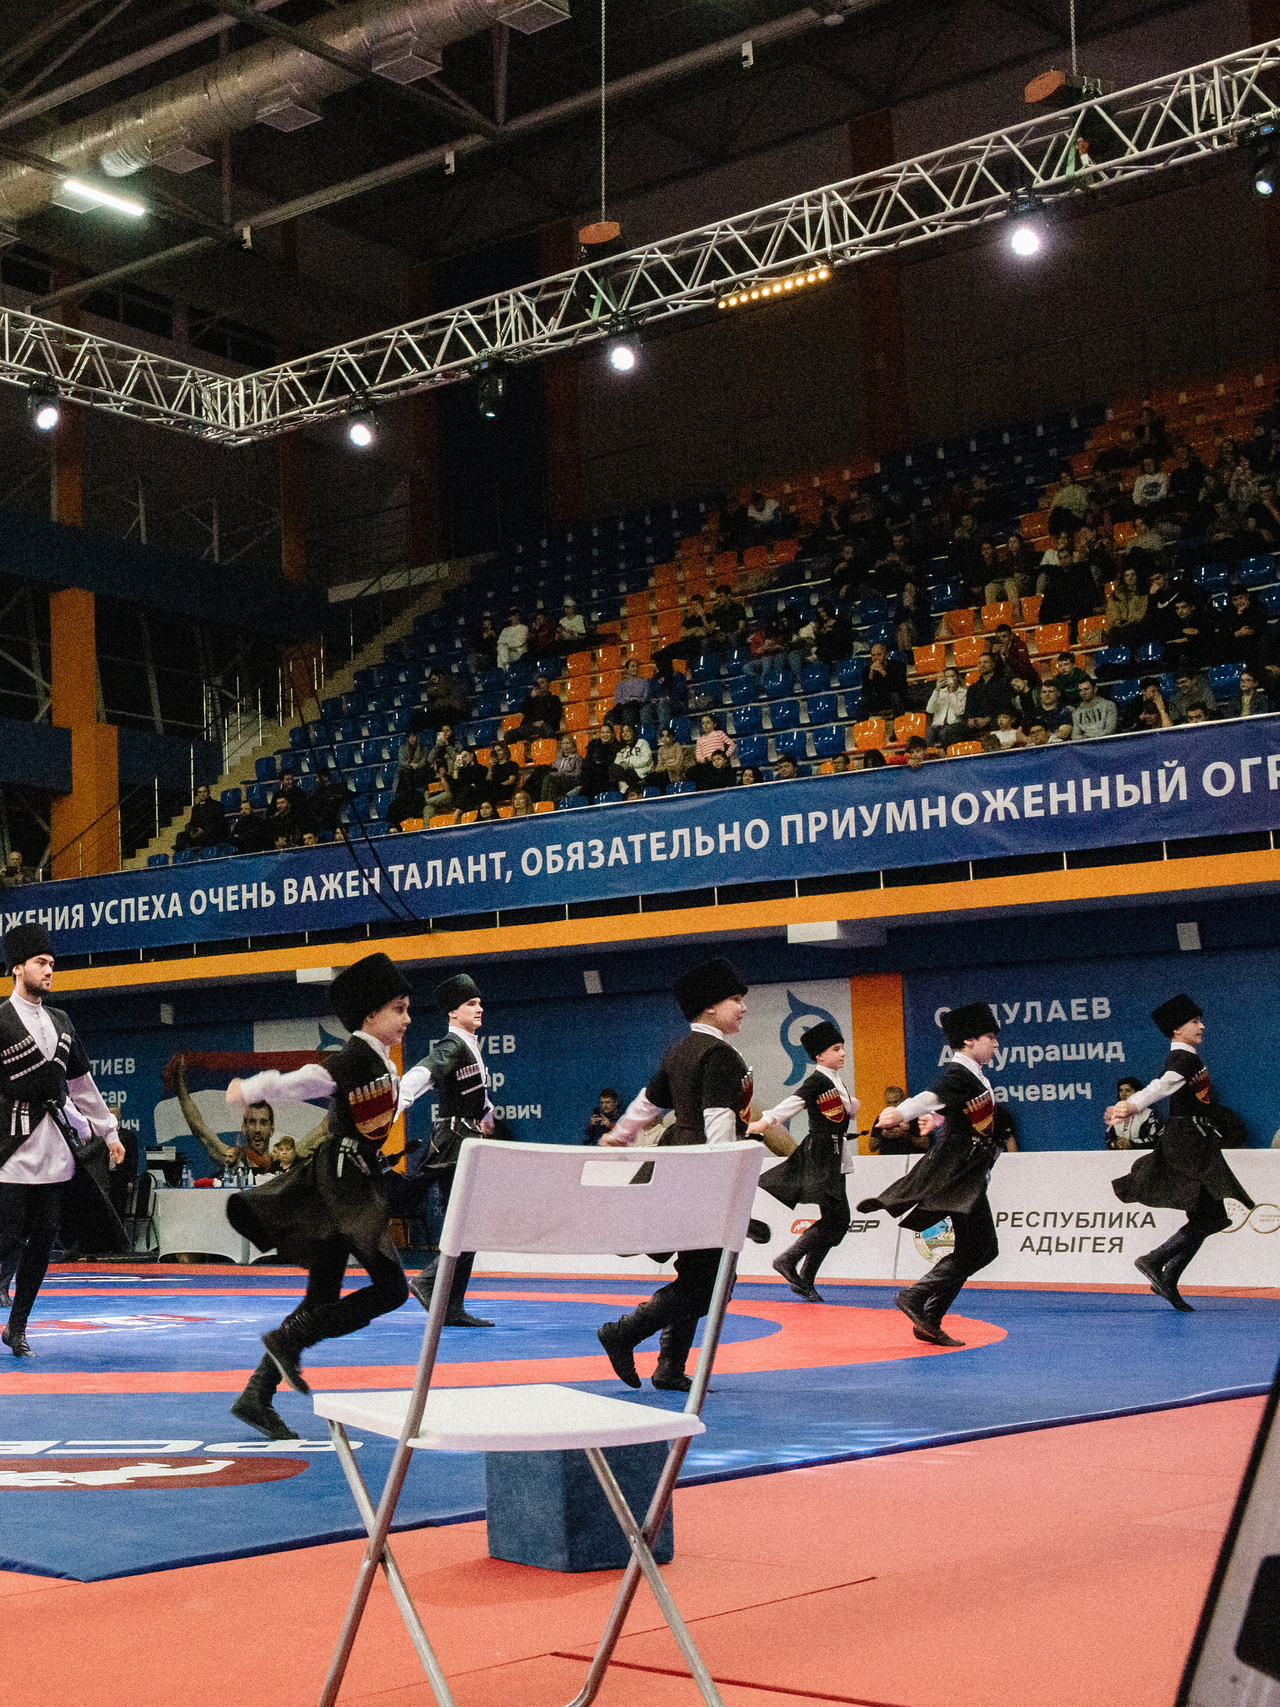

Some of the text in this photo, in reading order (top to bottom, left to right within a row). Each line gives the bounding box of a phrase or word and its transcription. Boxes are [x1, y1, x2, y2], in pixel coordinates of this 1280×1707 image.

[90, 892, 183, 926] УСПЕХА
[189, 882, 276, 915] ОЧЕНЬ
[283, 867, 380, 905] ВАЖЕН
[388, 851, 513, 891] ТАЛАНТ,
[521, 818, 770, 876] ОБЯЗАТЕЛЬНО
[780, 760, 1188, 846] ПРИУМНОЖЕННЫЙ
[995, 1211, 1157, 1229] РЕСПУБЛИКА
[1019, 1235, 1124, 1256] АДЫГЕЯ
